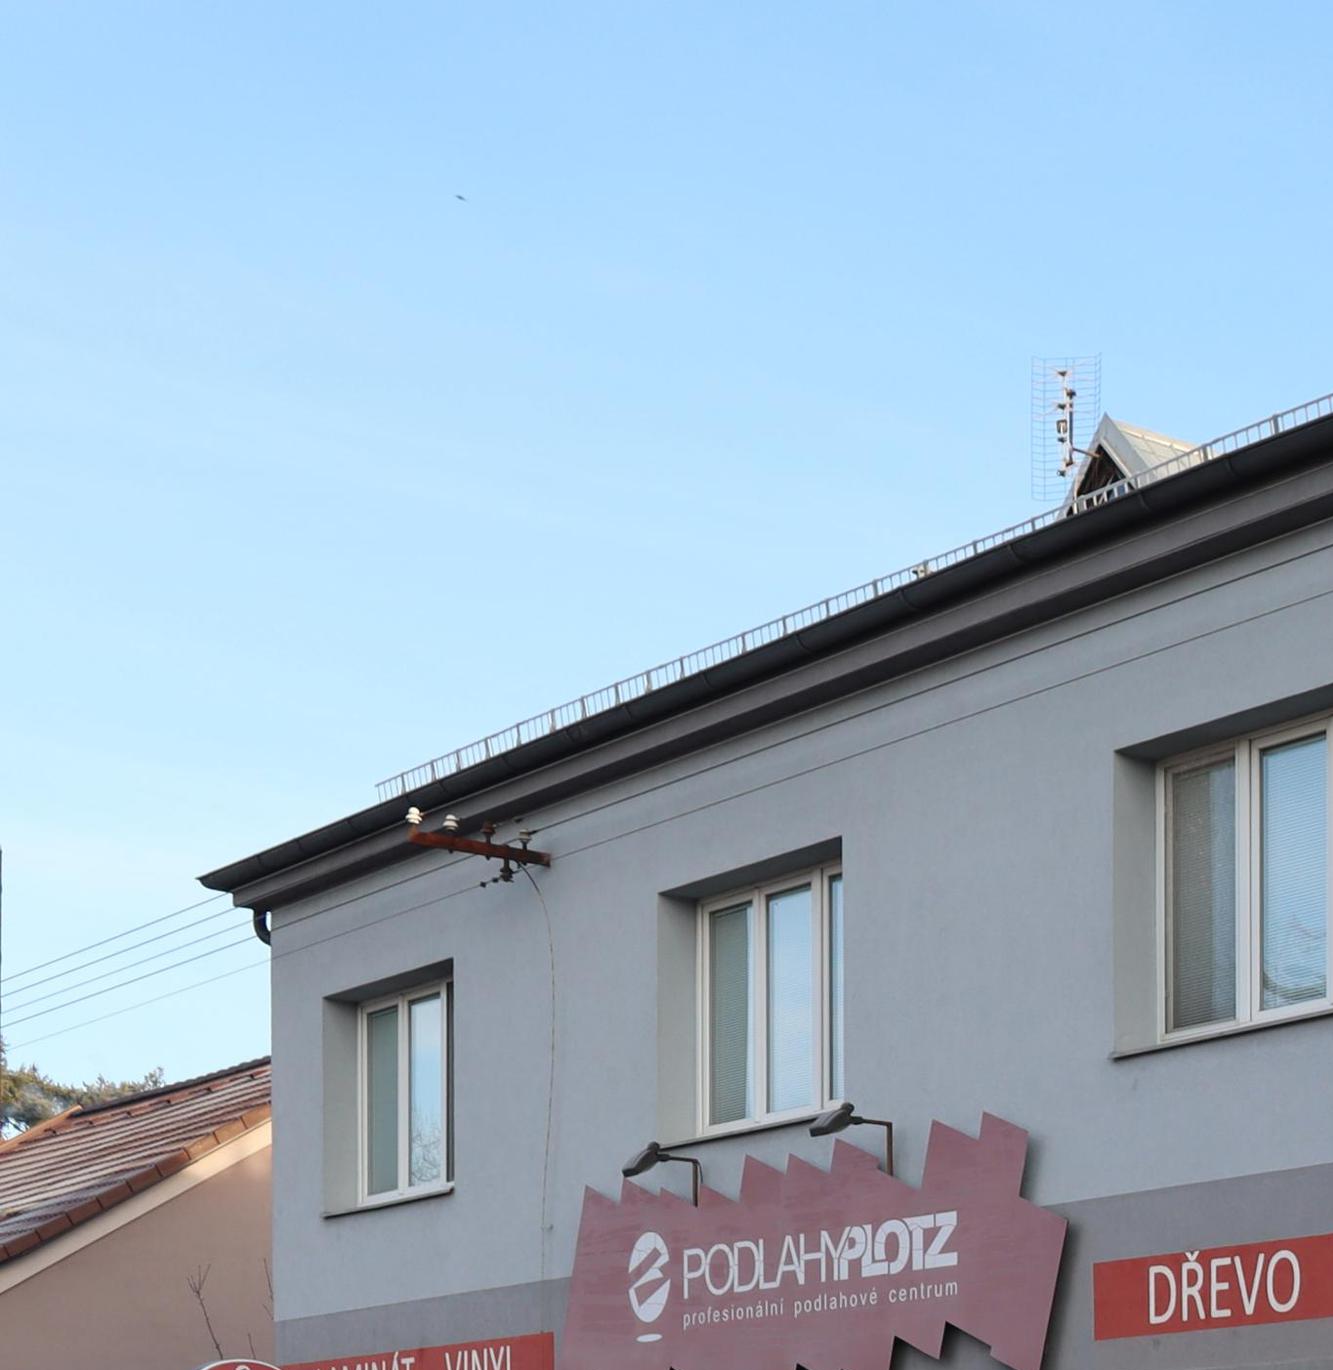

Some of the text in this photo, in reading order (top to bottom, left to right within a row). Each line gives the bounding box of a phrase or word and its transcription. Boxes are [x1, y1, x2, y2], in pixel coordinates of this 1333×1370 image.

[683, 1280, 958, 1330] profesionální podlahové centrum
[1148, 1249, 1301, 1325] DŘEVO
